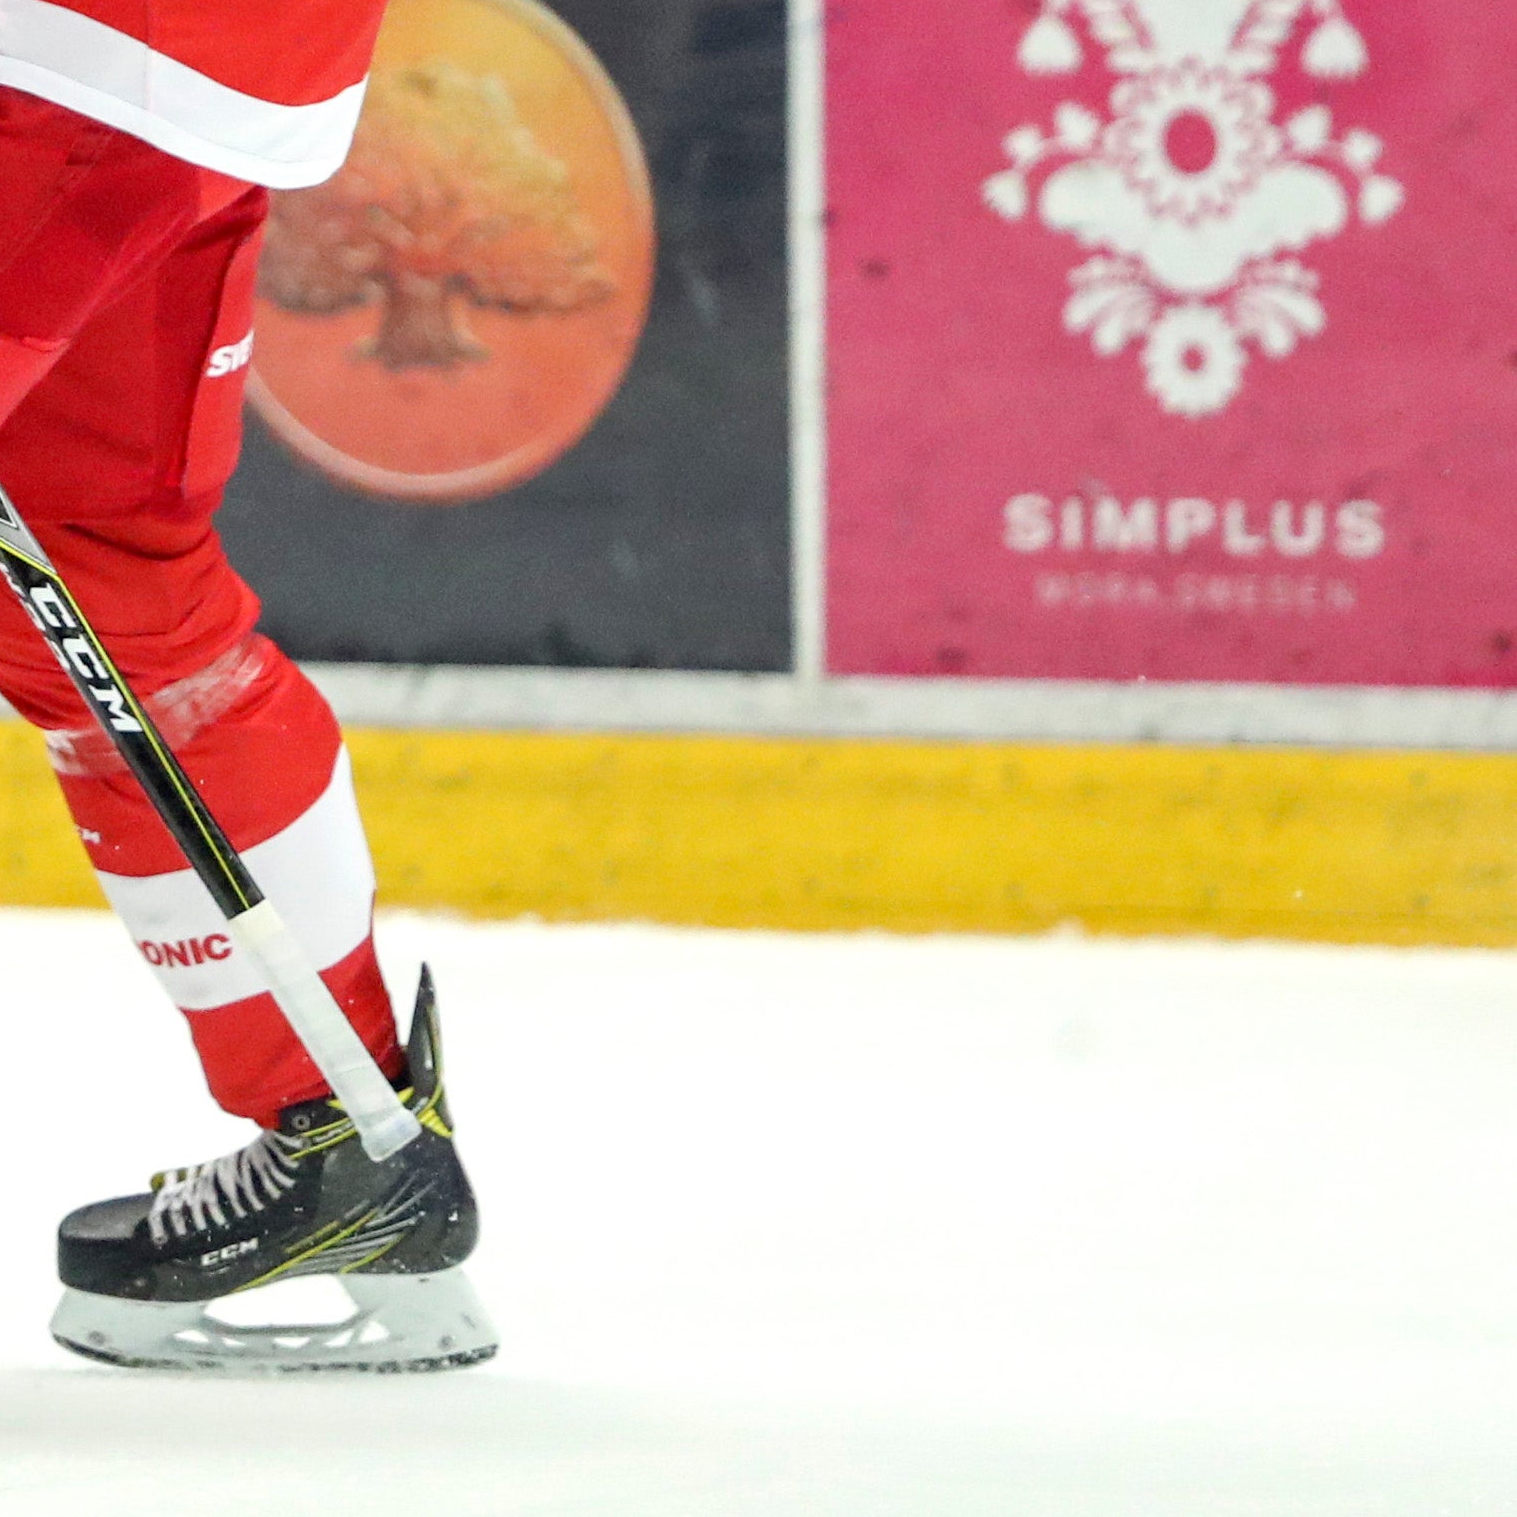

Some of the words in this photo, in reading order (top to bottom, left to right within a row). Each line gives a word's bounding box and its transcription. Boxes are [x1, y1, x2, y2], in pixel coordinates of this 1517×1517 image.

[1002, 490, 1386, 559] SIMPLUS
[29, 581, 145, 734] CCM
[201, 1237, 260, 1267] CCM
